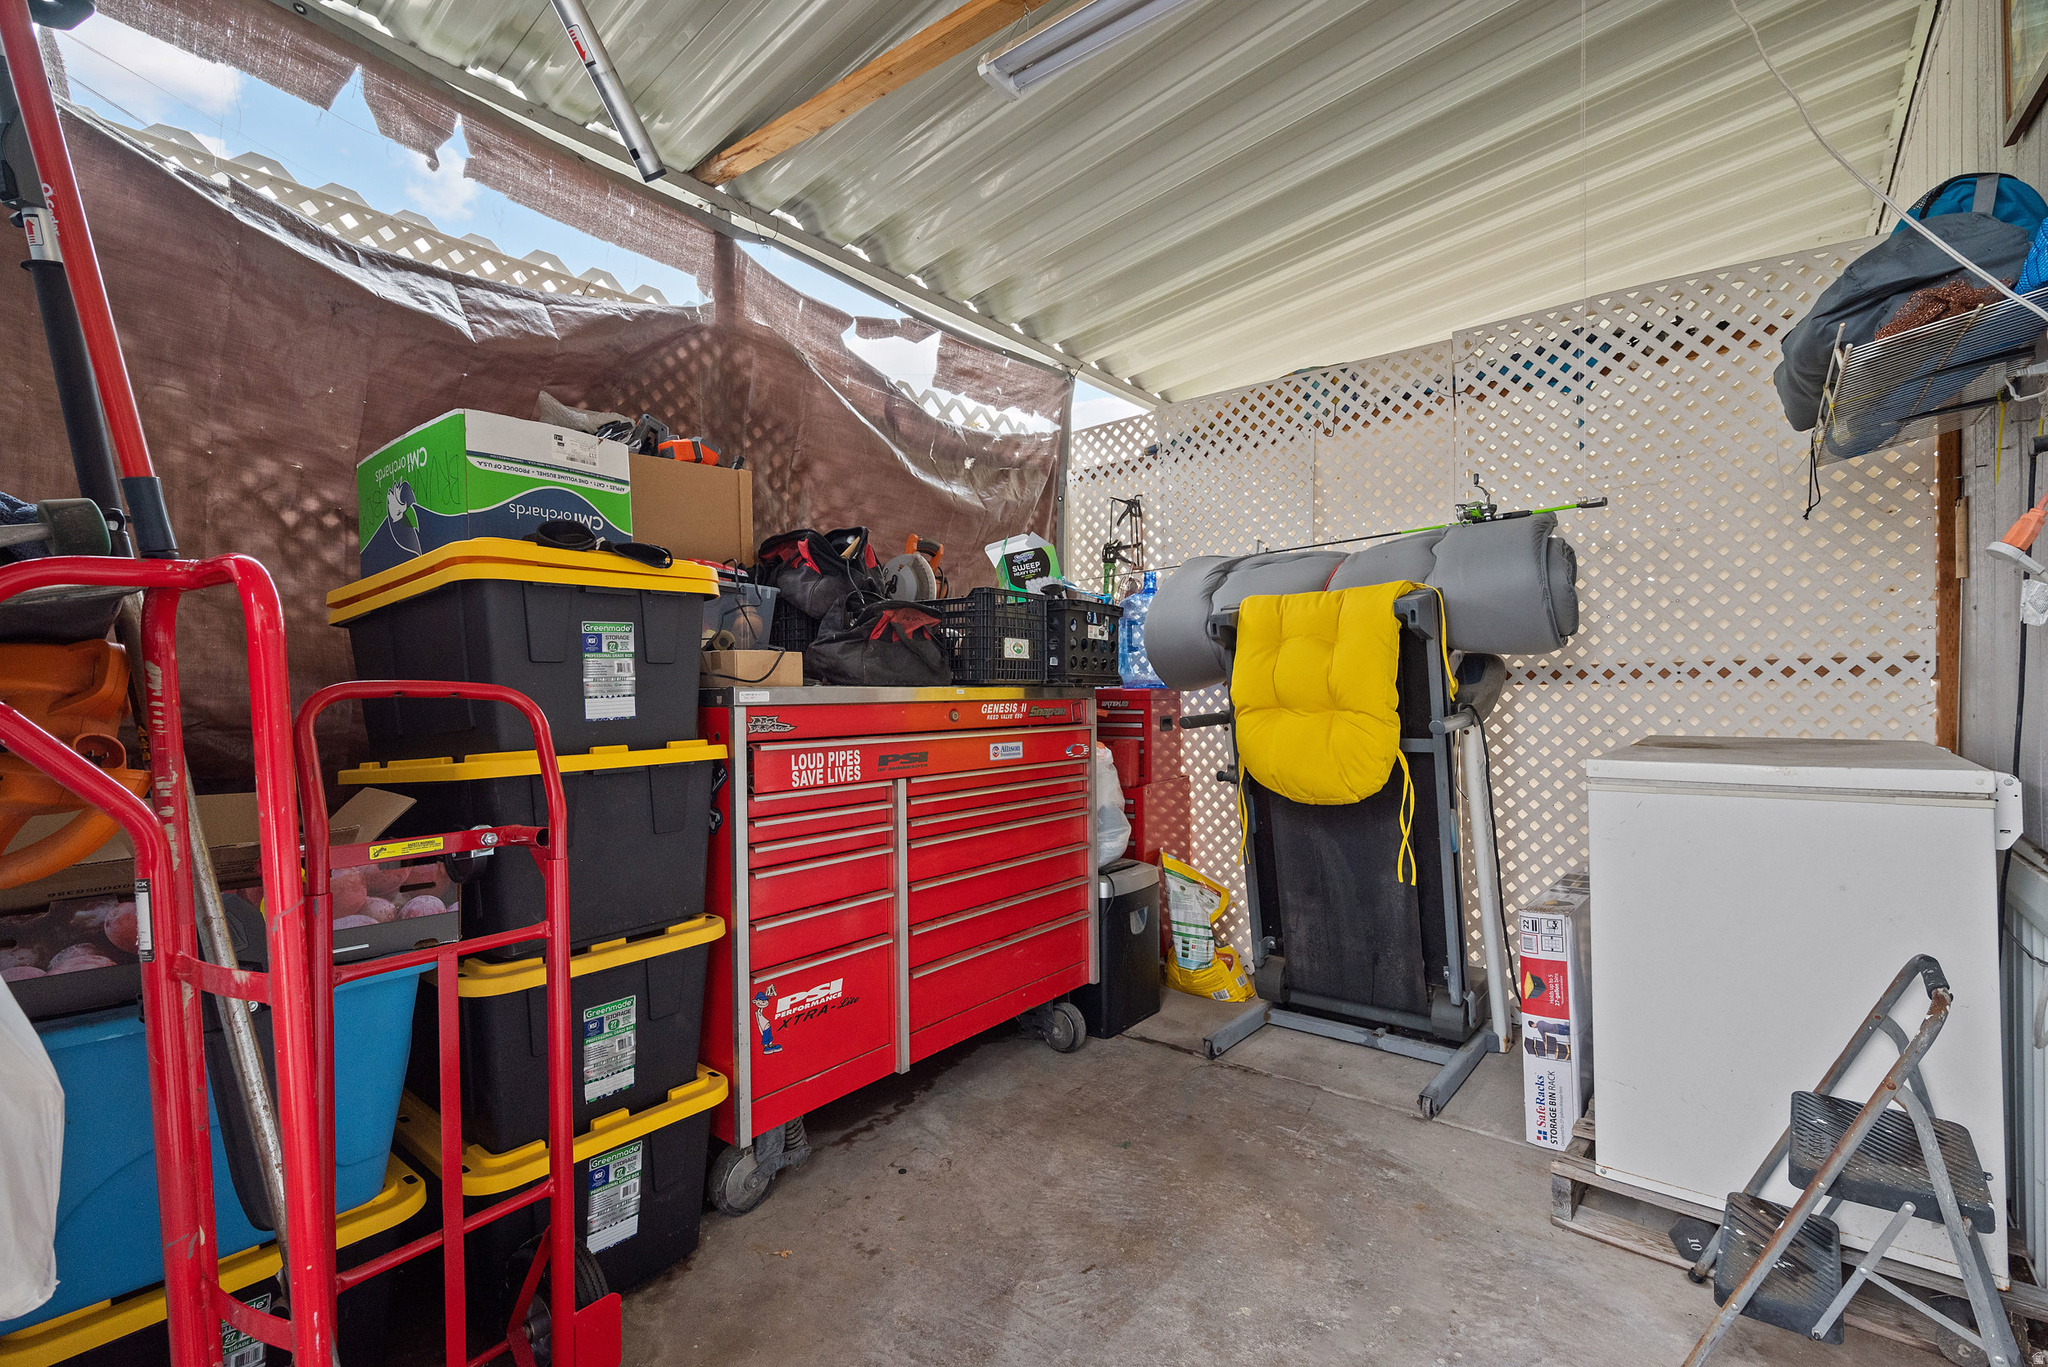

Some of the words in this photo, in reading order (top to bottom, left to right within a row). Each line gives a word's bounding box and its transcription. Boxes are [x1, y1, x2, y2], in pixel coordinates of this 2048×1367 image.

[407, 446, 428, 473] CMI
[375, 456, 407, 488] orchards
[503, 464, 530, 475] PRODUCE
[535, 470, 557, 479] BUSHEL
[557, 474, 579, 483] VOLUME
[609, 484, 626, 492] APPLES
[508, 503, 572, 523] orchards
[573, 512, 604, 531] CMI
[1012, 561, 1041, 573] SWEEP
[1013, 569, 1029, 577] HEAVY
[1029, 567, 1042, 575] DUTY
[981, 703, 1018, 714] GENESIS
[1000, 745, 1021, 753] Allison
[791, 752, 825, 771] LOUD
[828, 749, 861, 768] PIPES
[878, 751, 929, 767] PSI
[888, 763, 929, 771] MINNESOTA
[791, 768, 825, 788] SAVE
[828, 765, 862, 783] LIVES
[1522, 919, 1530, 930] 22
[776, 977, 844, 1014] PSI
[774, 991, 843, 1020] PERFORMANCE
[605, 1008, 632, 1021] STORAGE
[610, 1020, 618, 1028] 27
[585, 1032, 613, 1044] PROFESSIONAL
[1547, 1070, 1556, 1091] RACK
[1535, 1074, 1547, 1128] SafeRacks
[1548, 1091, 1557, 1106] BIN
[1549, 1107, 1558, 1145] STORAGE
[612, 1156, 638, 1169] STORAGE
[616, 1168, 624, 1177] 27
[590, 1182, 618, 1195] PROFESSIONAL
[618, 1176, 631, 1184] GRADE
[1687, 1237, 1702, 1251] 10
[225, 1332, 236, 1343] 27
[229, 1340, 250, 1352] GRADE
